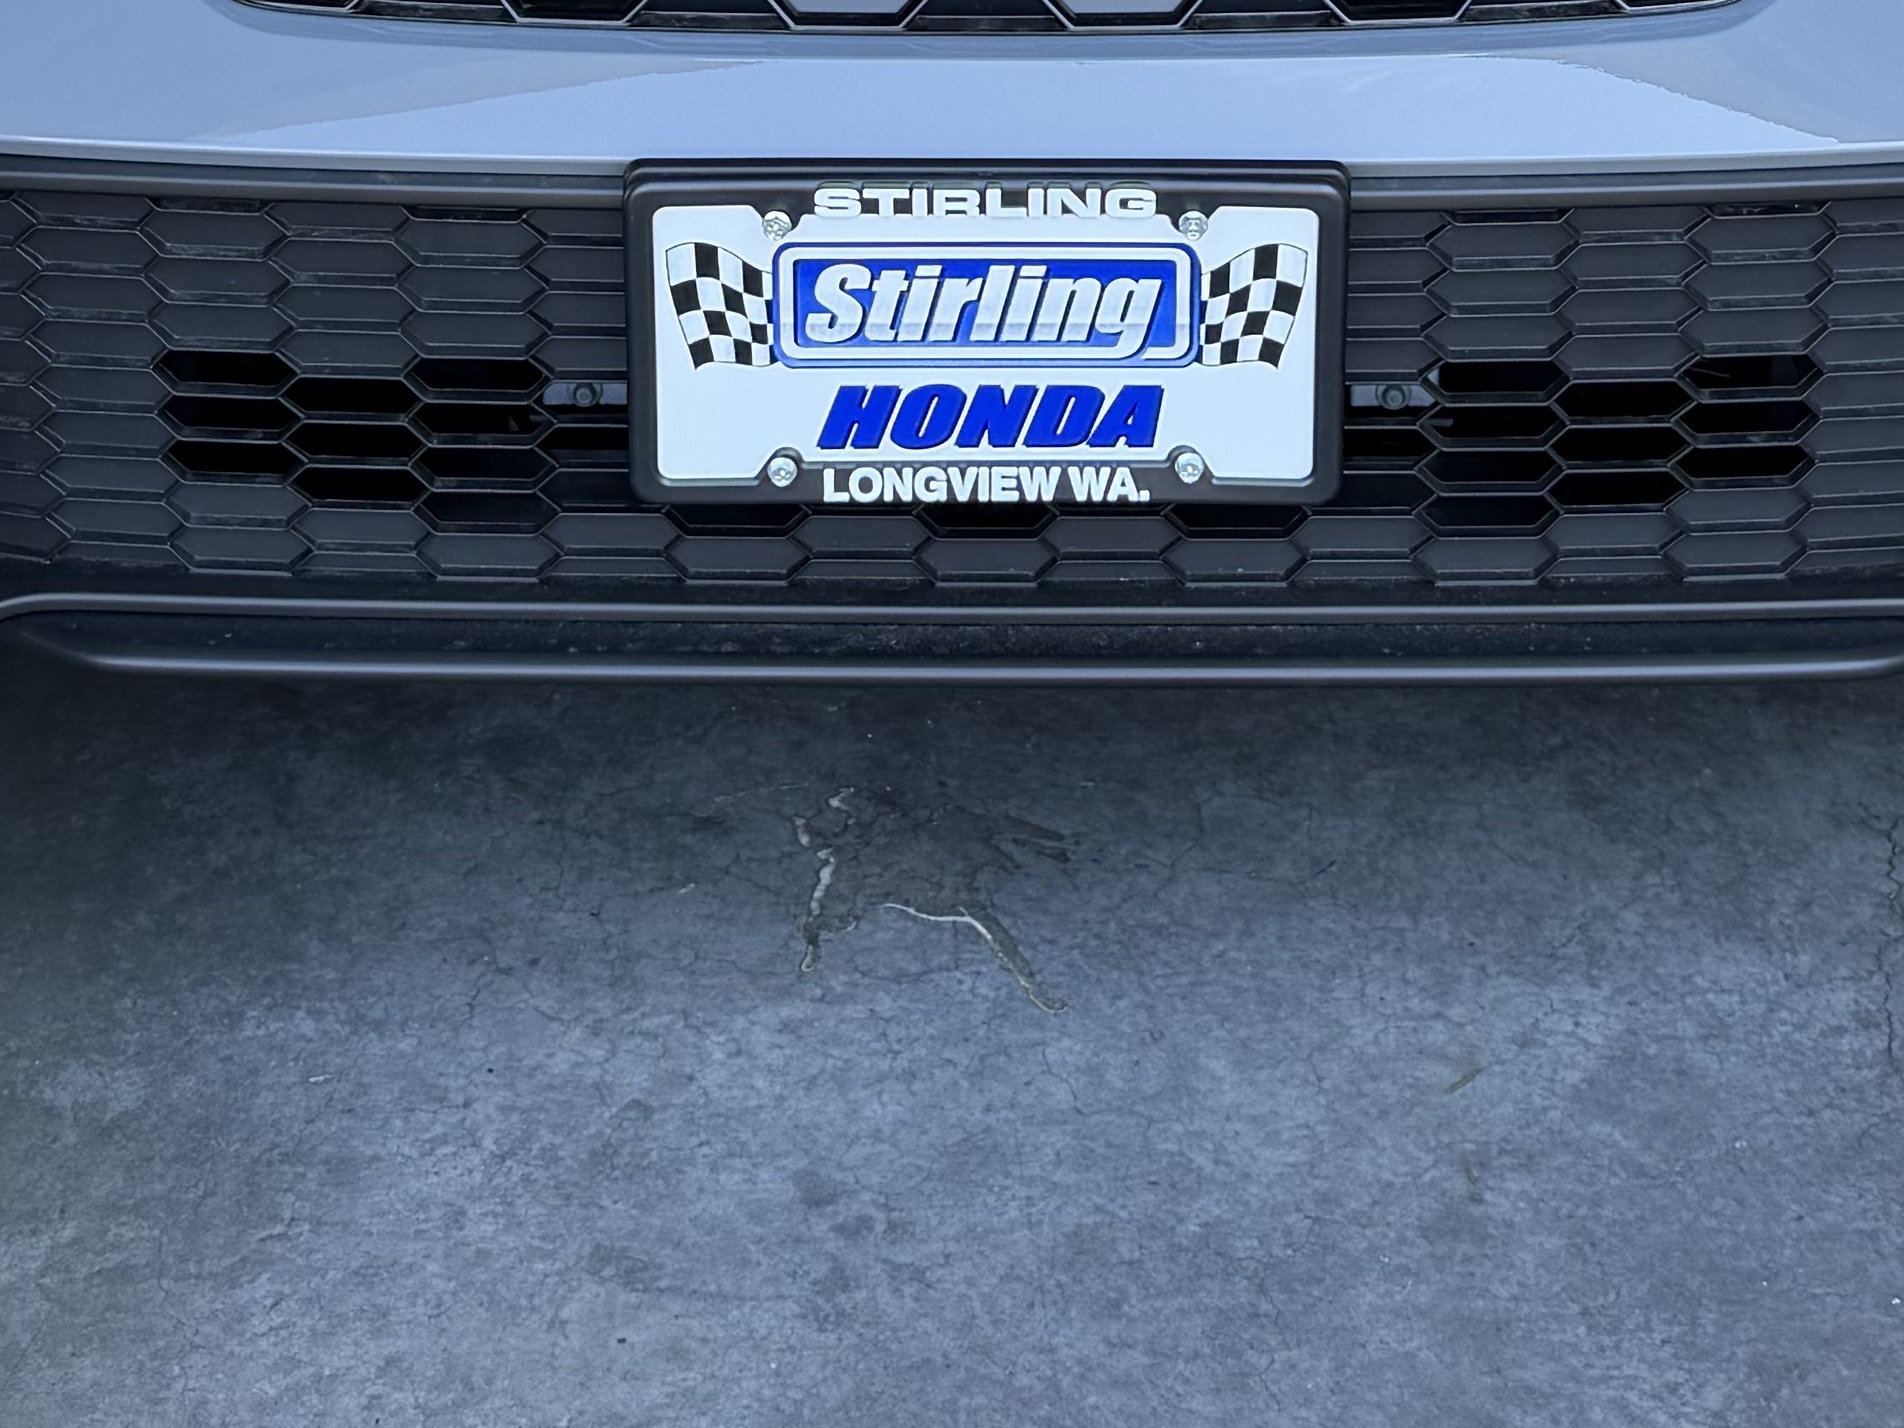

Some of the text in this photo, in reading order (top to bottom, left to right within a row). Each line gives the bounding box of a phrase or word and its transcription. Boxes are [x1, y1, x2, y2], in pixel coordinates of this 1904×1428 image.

[813, 187, 1157, 219] STIRLING
[804, 263, 1161, 359] Stirling
[816, 384, 1165, 450] HONDA
[822, 467, 1151, 504] LONGVIEW WA.
